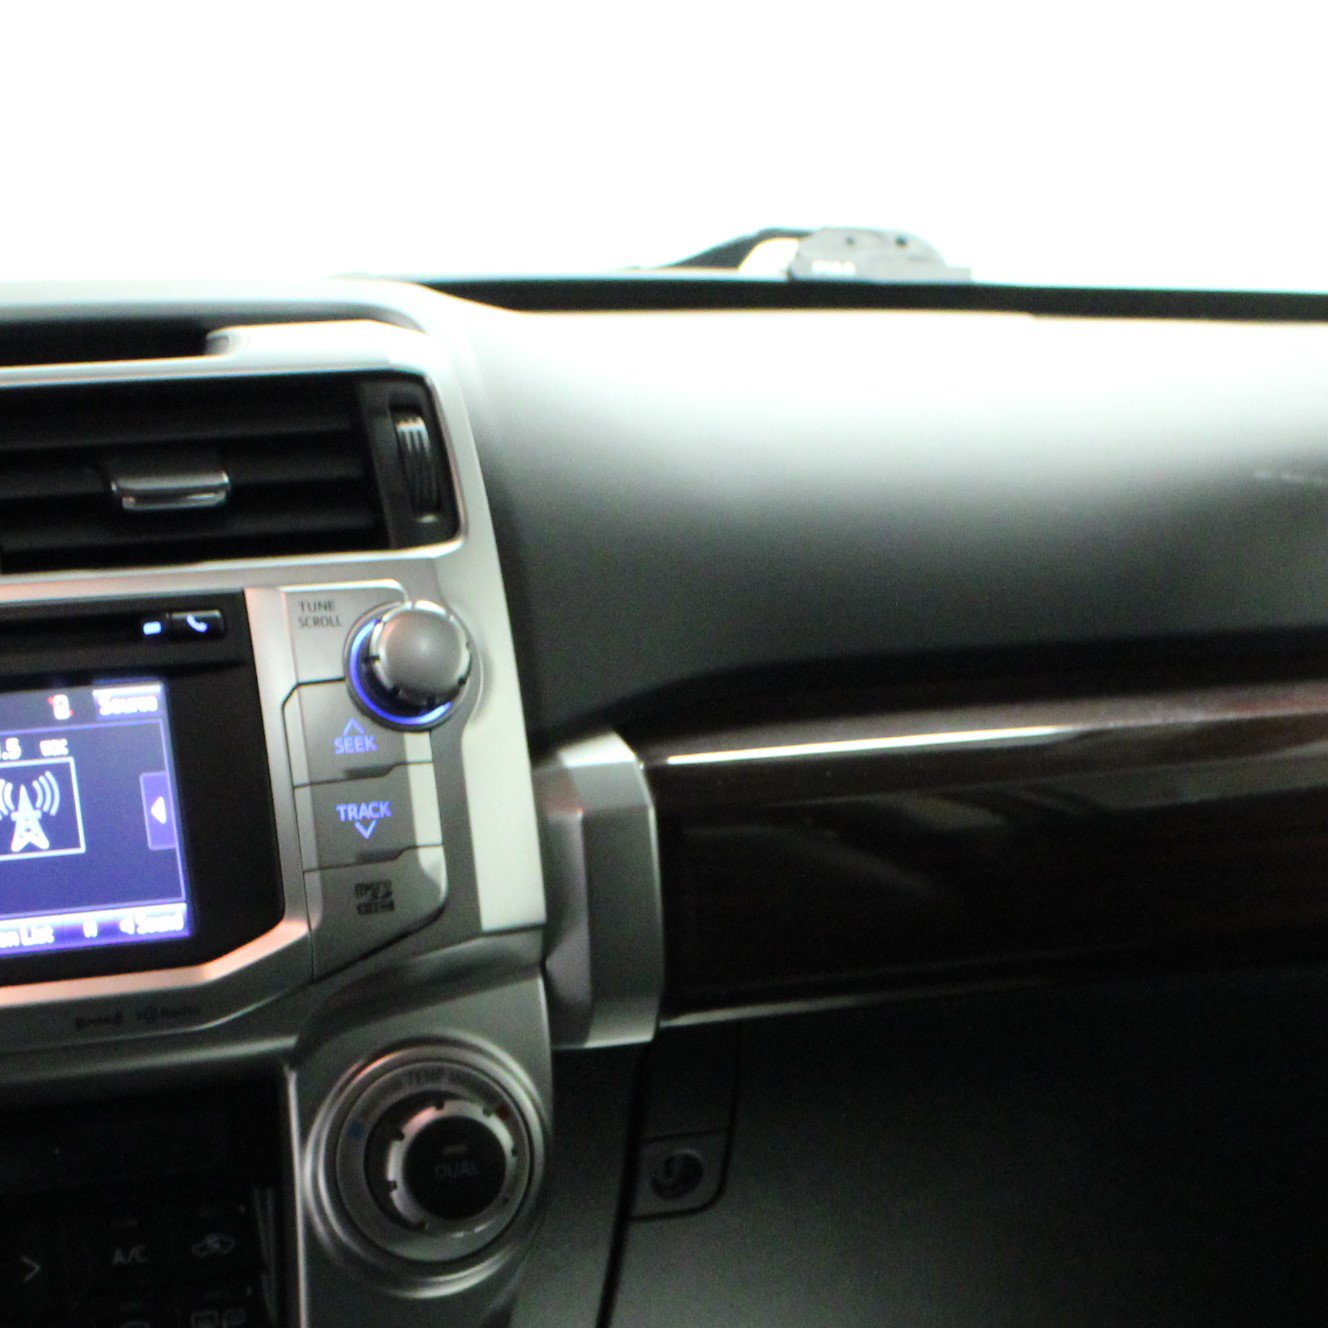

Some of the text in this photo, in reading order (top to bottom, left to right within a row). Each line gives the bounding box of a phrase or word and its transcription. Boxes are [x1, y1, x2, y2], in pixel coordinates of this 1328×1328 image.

[298, 600, 337, 614] TUNE
[296, 614, 343, 630] SCROLL
[332, 735, 378, 755] SEEK
[335, 801, 392, 822] TRACK
